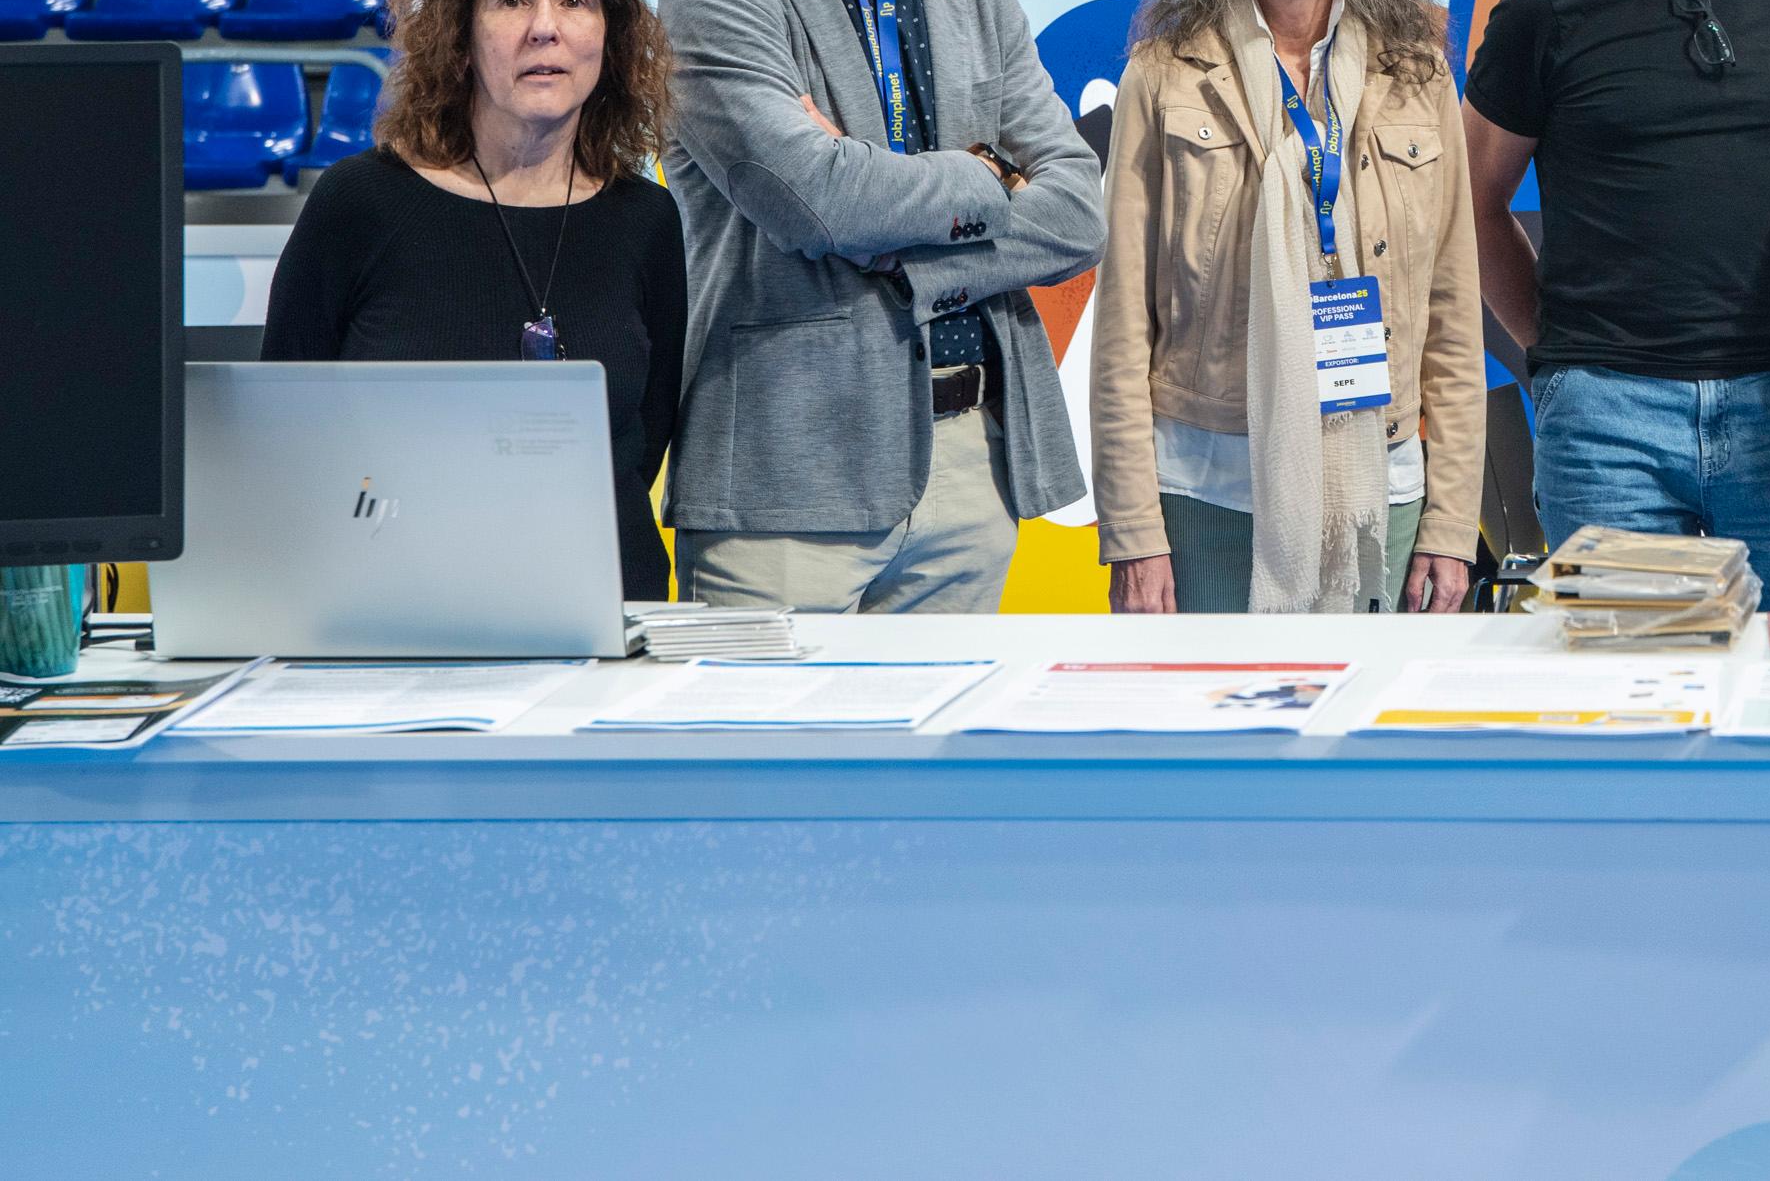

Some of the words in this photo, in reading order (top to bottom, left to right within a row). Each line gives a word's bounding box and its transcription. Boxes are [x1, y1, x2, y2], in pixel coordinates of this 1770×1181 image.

[888, 73, 905, 142] jobinplanet
[1311, 289, 1369, 304] Barcelona25
[1312, 303, 1366, 317] ROFESSIONAL
[1320, 314, 1334, 323] VIP
[1334, 312, 1354, 321] PASS
[1333, 378, 1356, 388] SEPE
[353, 476, 400, 539] hp
